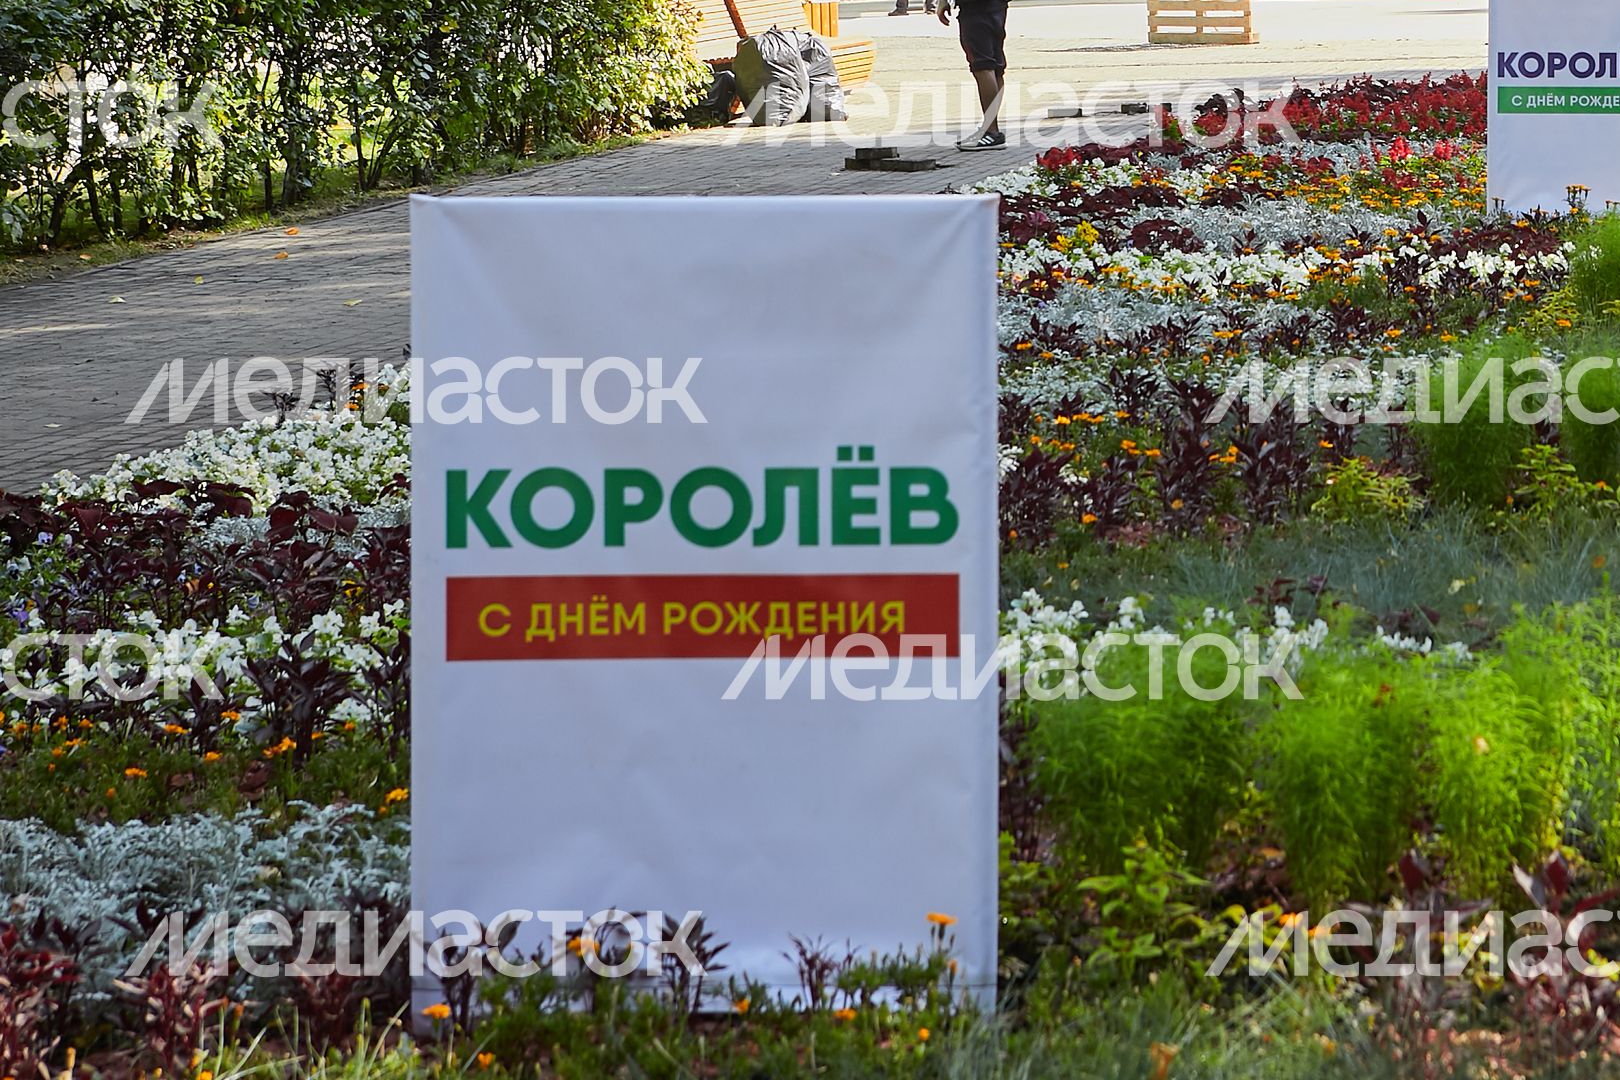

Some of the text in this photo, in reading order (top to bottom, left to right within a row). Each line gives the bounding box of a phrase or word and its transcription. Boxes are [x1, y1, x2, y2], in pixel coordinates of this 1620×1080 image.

[1511, 95, 1522, 106] С
[1526, 92, 1565, 108] ДНЁМ
[446, 445, 960, 549] КОРОЛЁВ
[478, 595, 906, 642] С ДНЁМ РОЖДЕНИЯ
